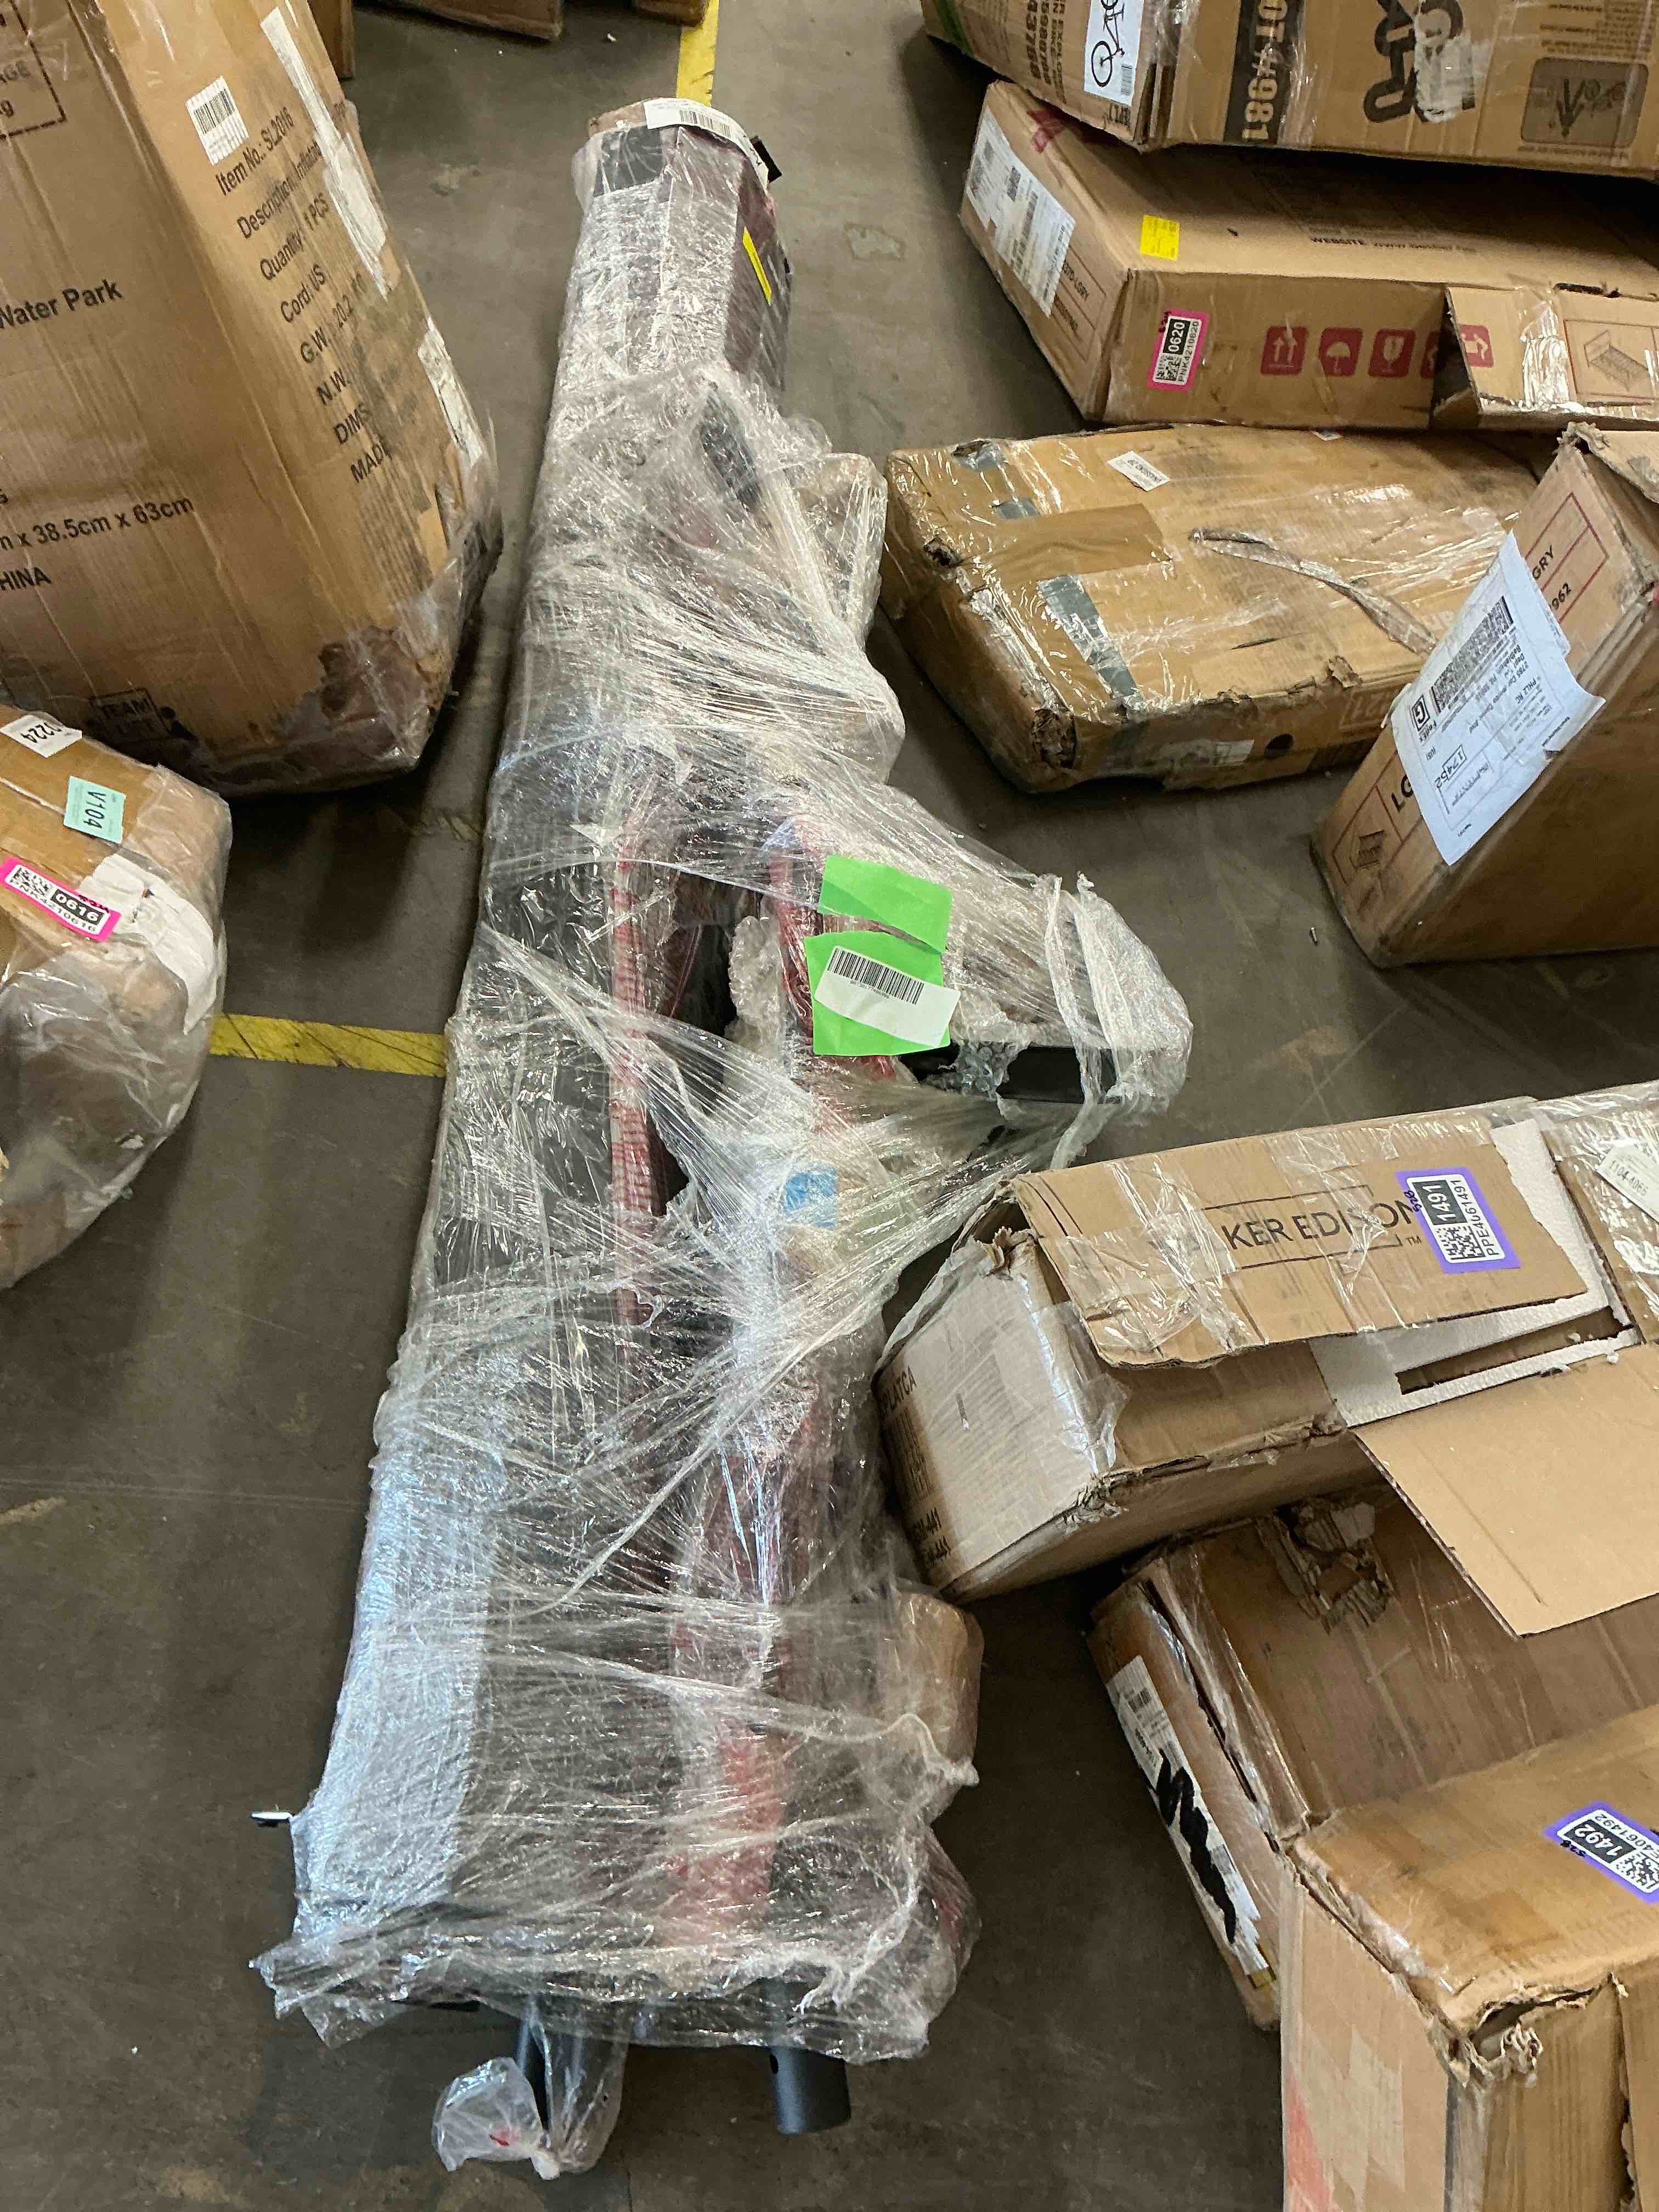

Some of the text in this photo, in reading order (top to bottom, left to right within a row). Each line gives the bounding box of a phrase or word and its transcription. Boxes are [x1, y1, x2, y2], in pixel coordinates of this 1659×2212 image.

[215, 162, 247, 196] Item
[62, 279, 123, 312] Park
[1168, 321, 1185, 352] 0620
[33, 516, 112, 545] 38.5cm
[114, 513, 131, 528] x
[132, 497, 195, 524] 63cm
[83, 790, 106, 829] V104
[55, 892, 100, 922] 0616
[1421, 1184, 1457, 1222] 1491
[1450, 1180, 1500, 1256] PPE4061491
[1221, 1218, 1294, 1250] KER
[1575, 1824, 1623, 1857] 1492
